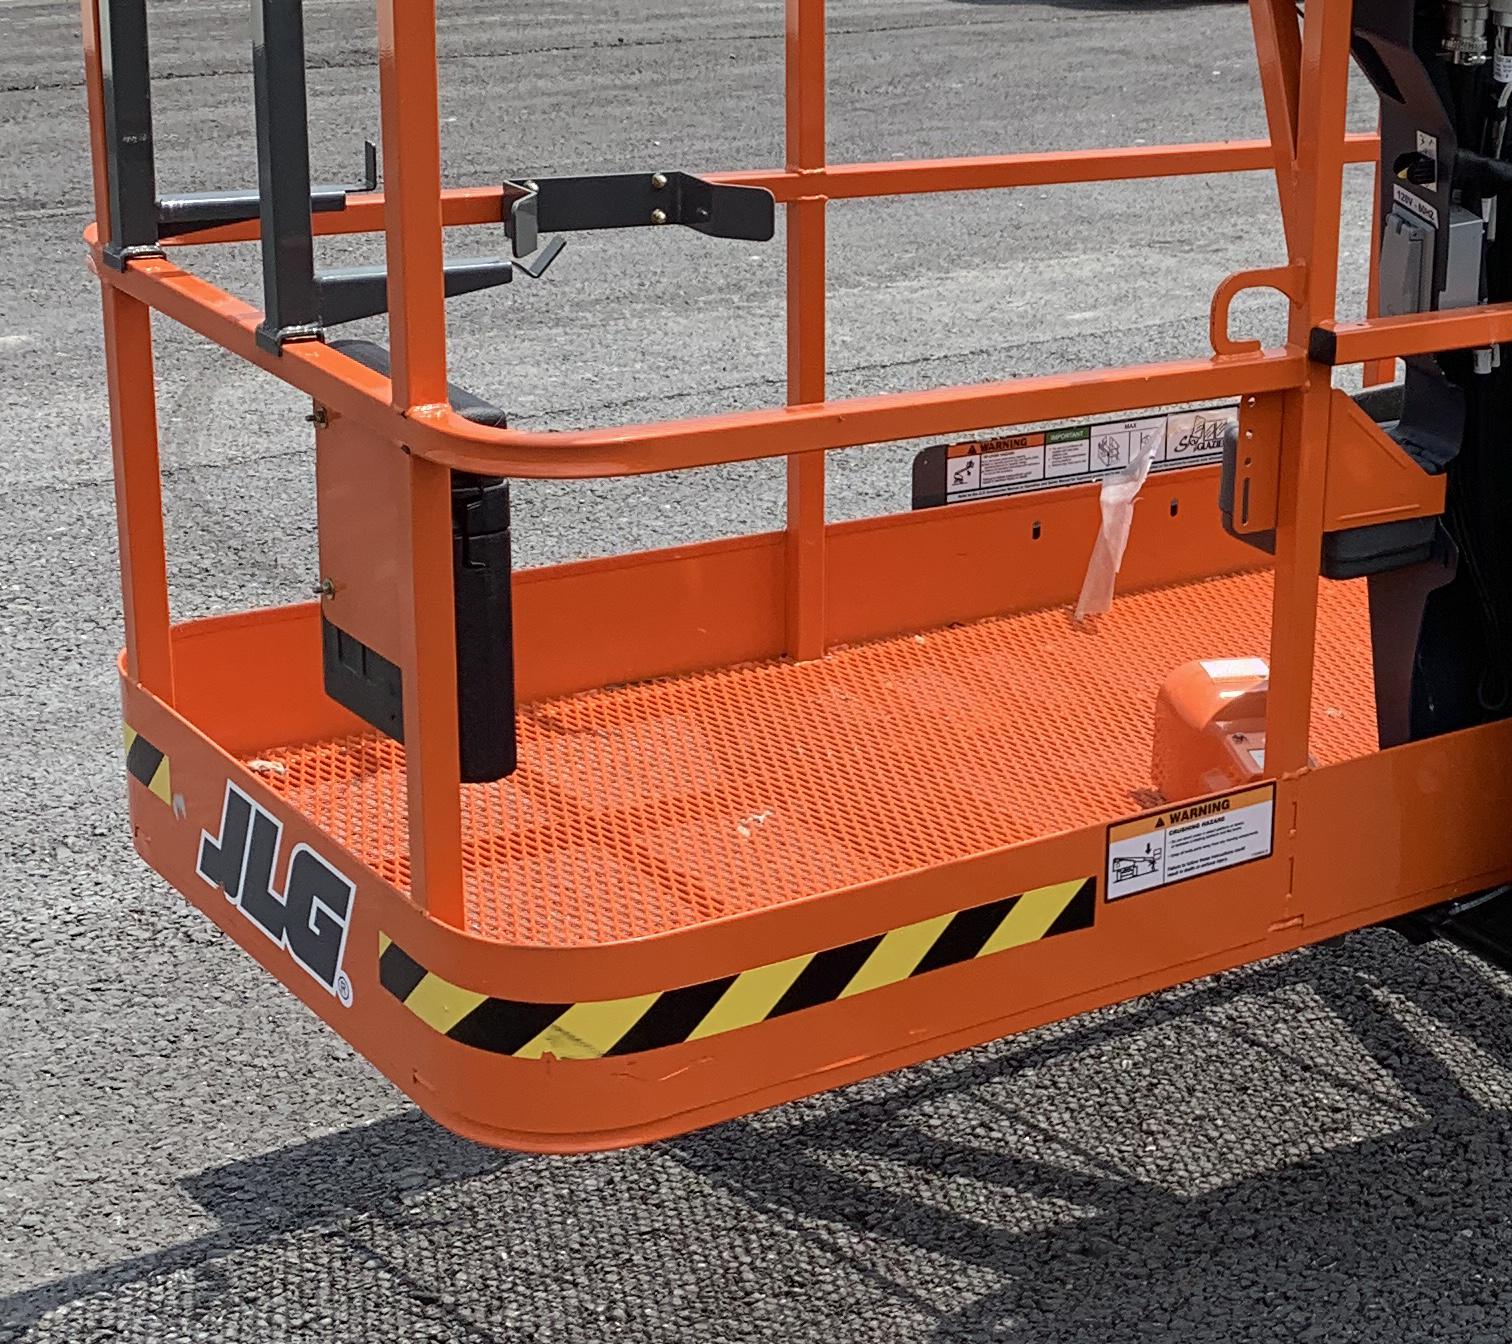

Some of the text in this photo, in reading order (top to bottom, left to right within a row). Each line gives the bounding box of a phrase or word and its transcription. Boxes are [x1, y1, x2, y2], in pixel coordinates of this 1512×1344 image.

[1124, 422, 1137, 430] MAX
[980, 437, 1028, 453] WARNING
[1050, 430, 1085, 442] IMPORTANT
[1169, 800, 1231, 824] WARNING
[1169, 816, 1226, 836] CRUSHING HAZARD
[196, 778, 357, 998] JLG
